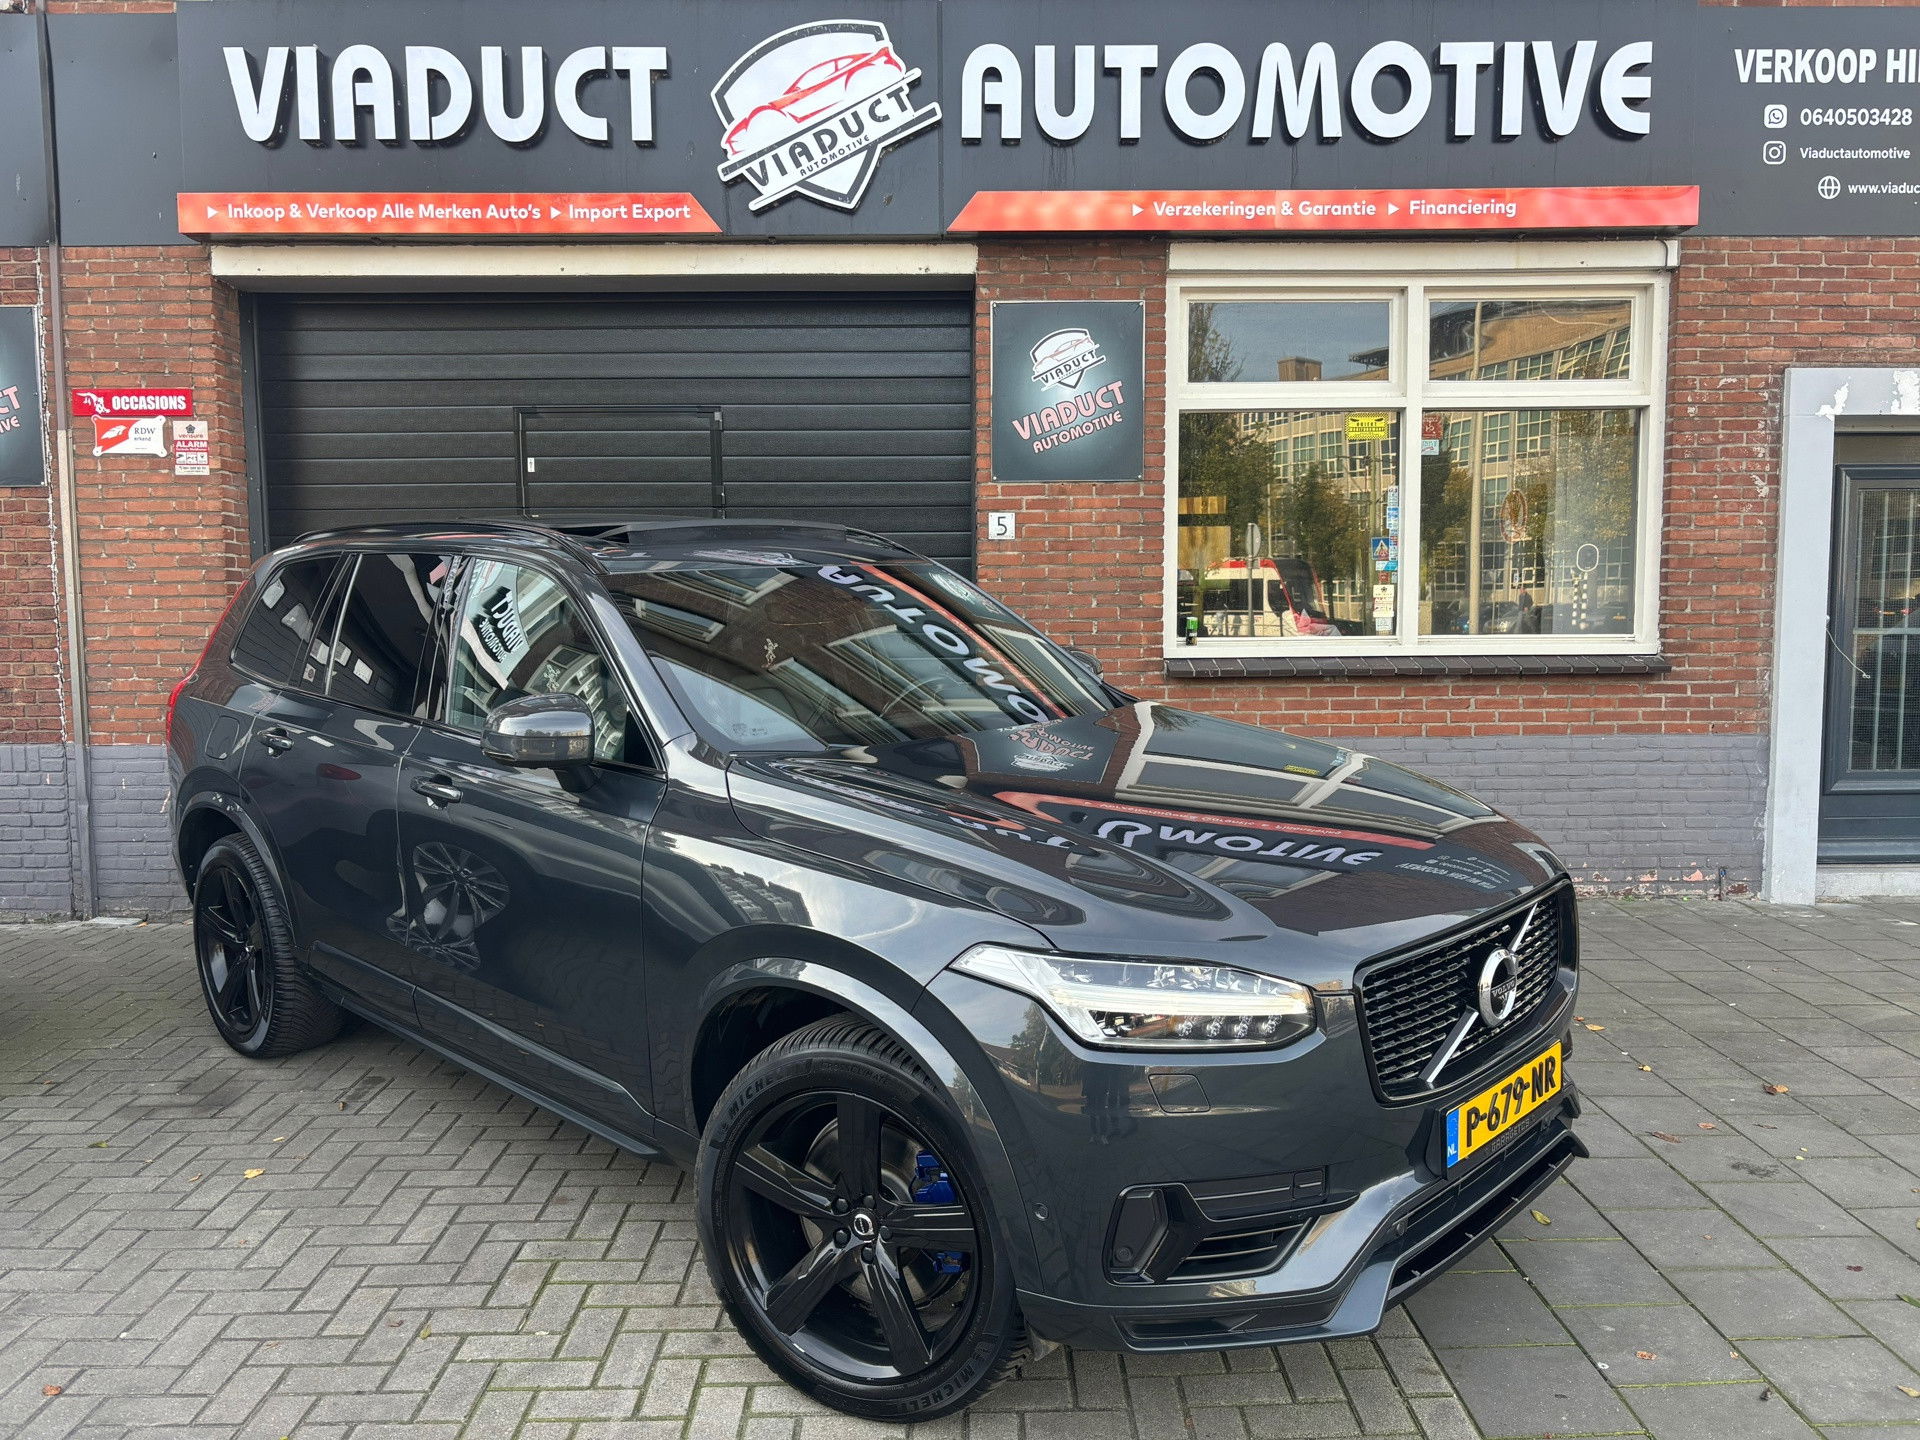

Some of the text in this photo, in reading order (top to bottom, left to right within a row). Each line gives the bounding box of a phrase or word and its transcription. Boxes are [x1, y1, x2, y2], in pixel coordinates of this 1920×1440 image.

[1734, 48, 1920, 83] VERKOOP HI
[223, 44, 667, 142] VIADUCT
[962, 40, 1653, 140] AUTOMOTIVE
[1800, 108, 1913, 126] 0640503428
[746, 86, 909, 187] VIADUCT
[800, 134, 870, 176] AUTOMOTIVE
[1800, 147, 1911, 159] Viaductautomotive
[227, 203, 541, 222] Inkoop & Verkoop Alle Merken Auto's
[569, 204, 691, 222] Import Export
[1154, 200, 1376, 219] Verzekeringen & Garantie
[1410, 199, 1517, 217] Financiering
[1041, 350, 1095, 383] VIADUCT
[111, 395, 187, 410] OCCASIONS
[1012, 381, 1125, 441] VIADUCT
[1032, 411, 1123, 454] AUTOMOTIVE
[175, 440, 208, 448] ALARM
[996, 517, 1008, 536] 5
[1466, 1055, 1556, 1148] P-679-NR
[1447, 1143, 1458, 1157] NL
